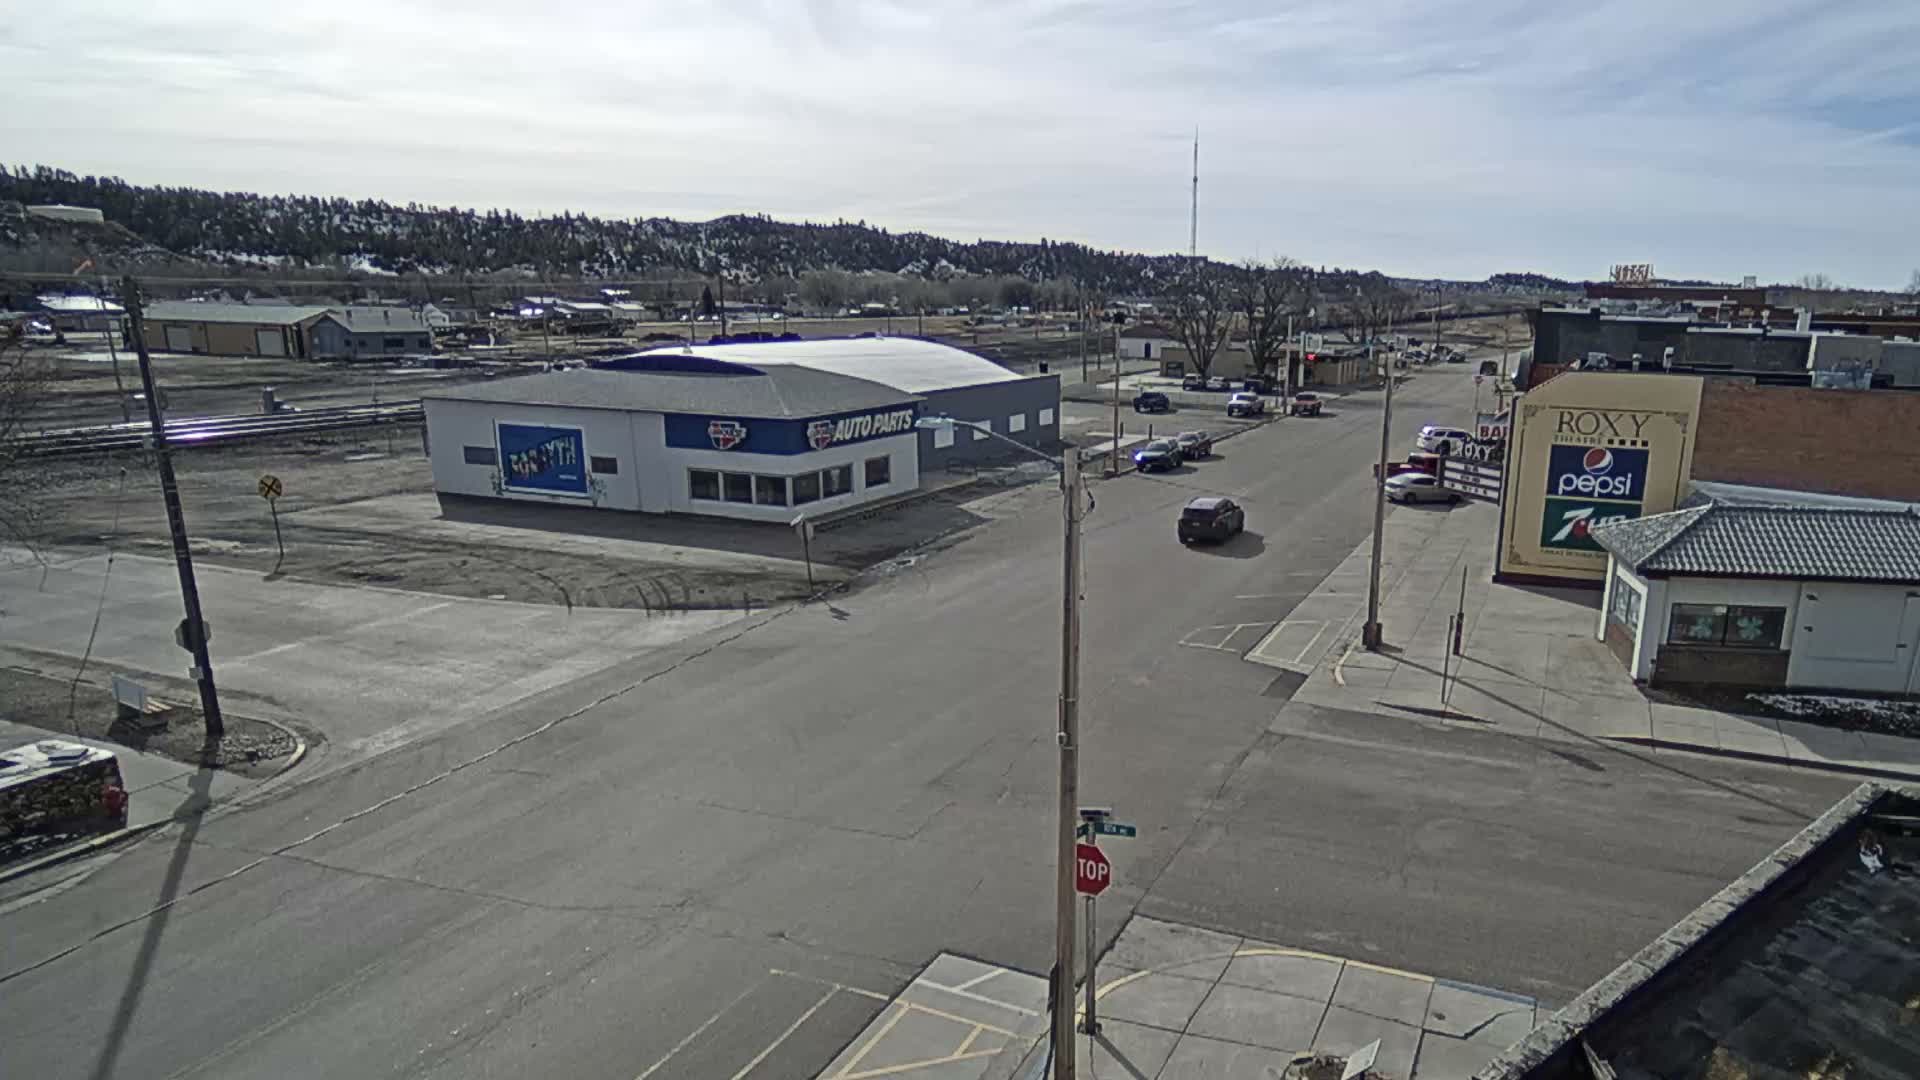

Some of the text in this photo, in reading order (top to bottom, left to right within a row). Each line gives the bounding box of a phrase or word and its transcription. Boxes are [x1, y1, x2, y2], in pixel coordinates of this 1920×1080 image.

[834, 418, 871, 441] AUTO
[872, 409, 913, 435] PARTS
[1557, 411, 1651, 437] ROXY
[1558, 473, 1632, 497] pepsi
[1078, 858, 1108, 881] TOP
